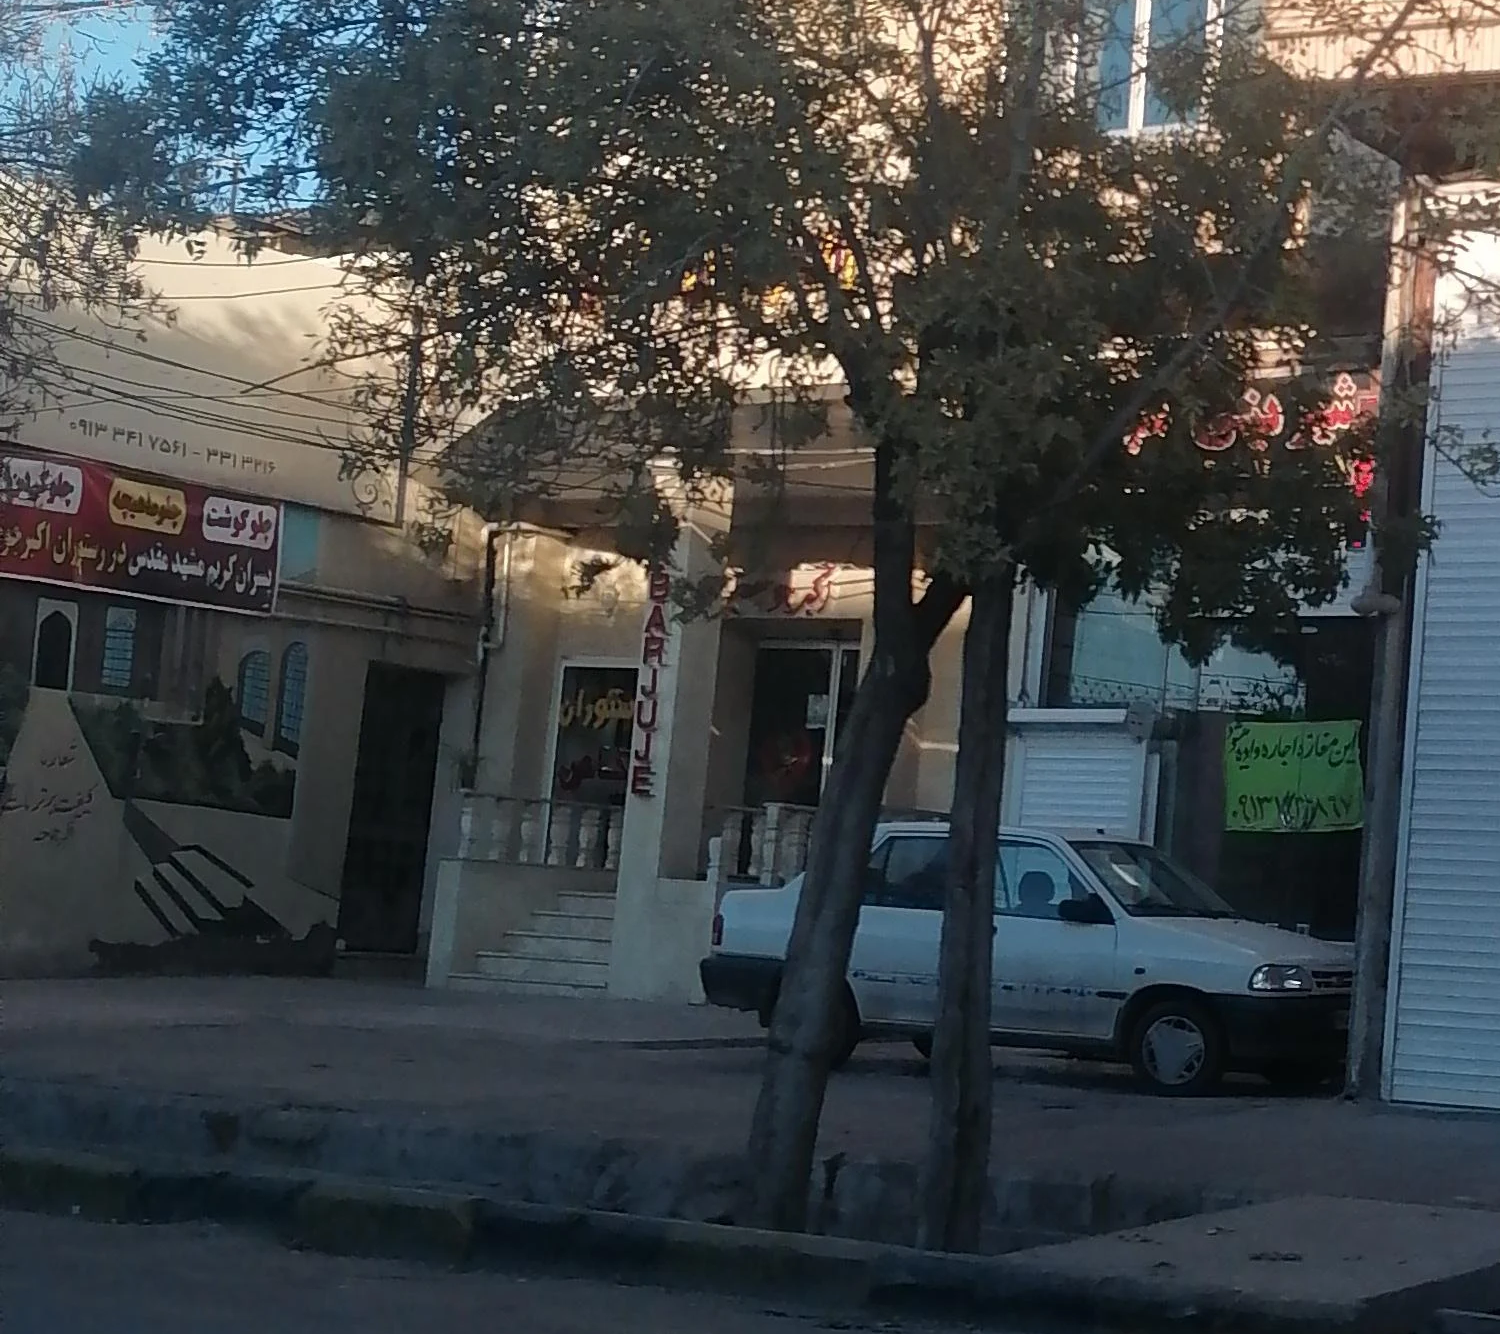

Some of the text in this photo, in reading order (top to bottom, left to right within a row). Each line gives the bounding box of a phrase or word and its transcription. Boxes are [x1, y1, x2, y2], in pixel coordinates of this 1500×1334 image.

[69, 418, 107, 439] ۰۹۱۳
[112, 426, 143, 447] ۳۴۱
[148, 434, 186, 458] ۷۵۶۱
[20, 520, 51, 560] اکبر
[107, 541, 127, 573] در
[631, 565, 671, 800] BARJUJE
[559, 687, 635, 730] ستوران
[1328, 731, 1357, 768] این
